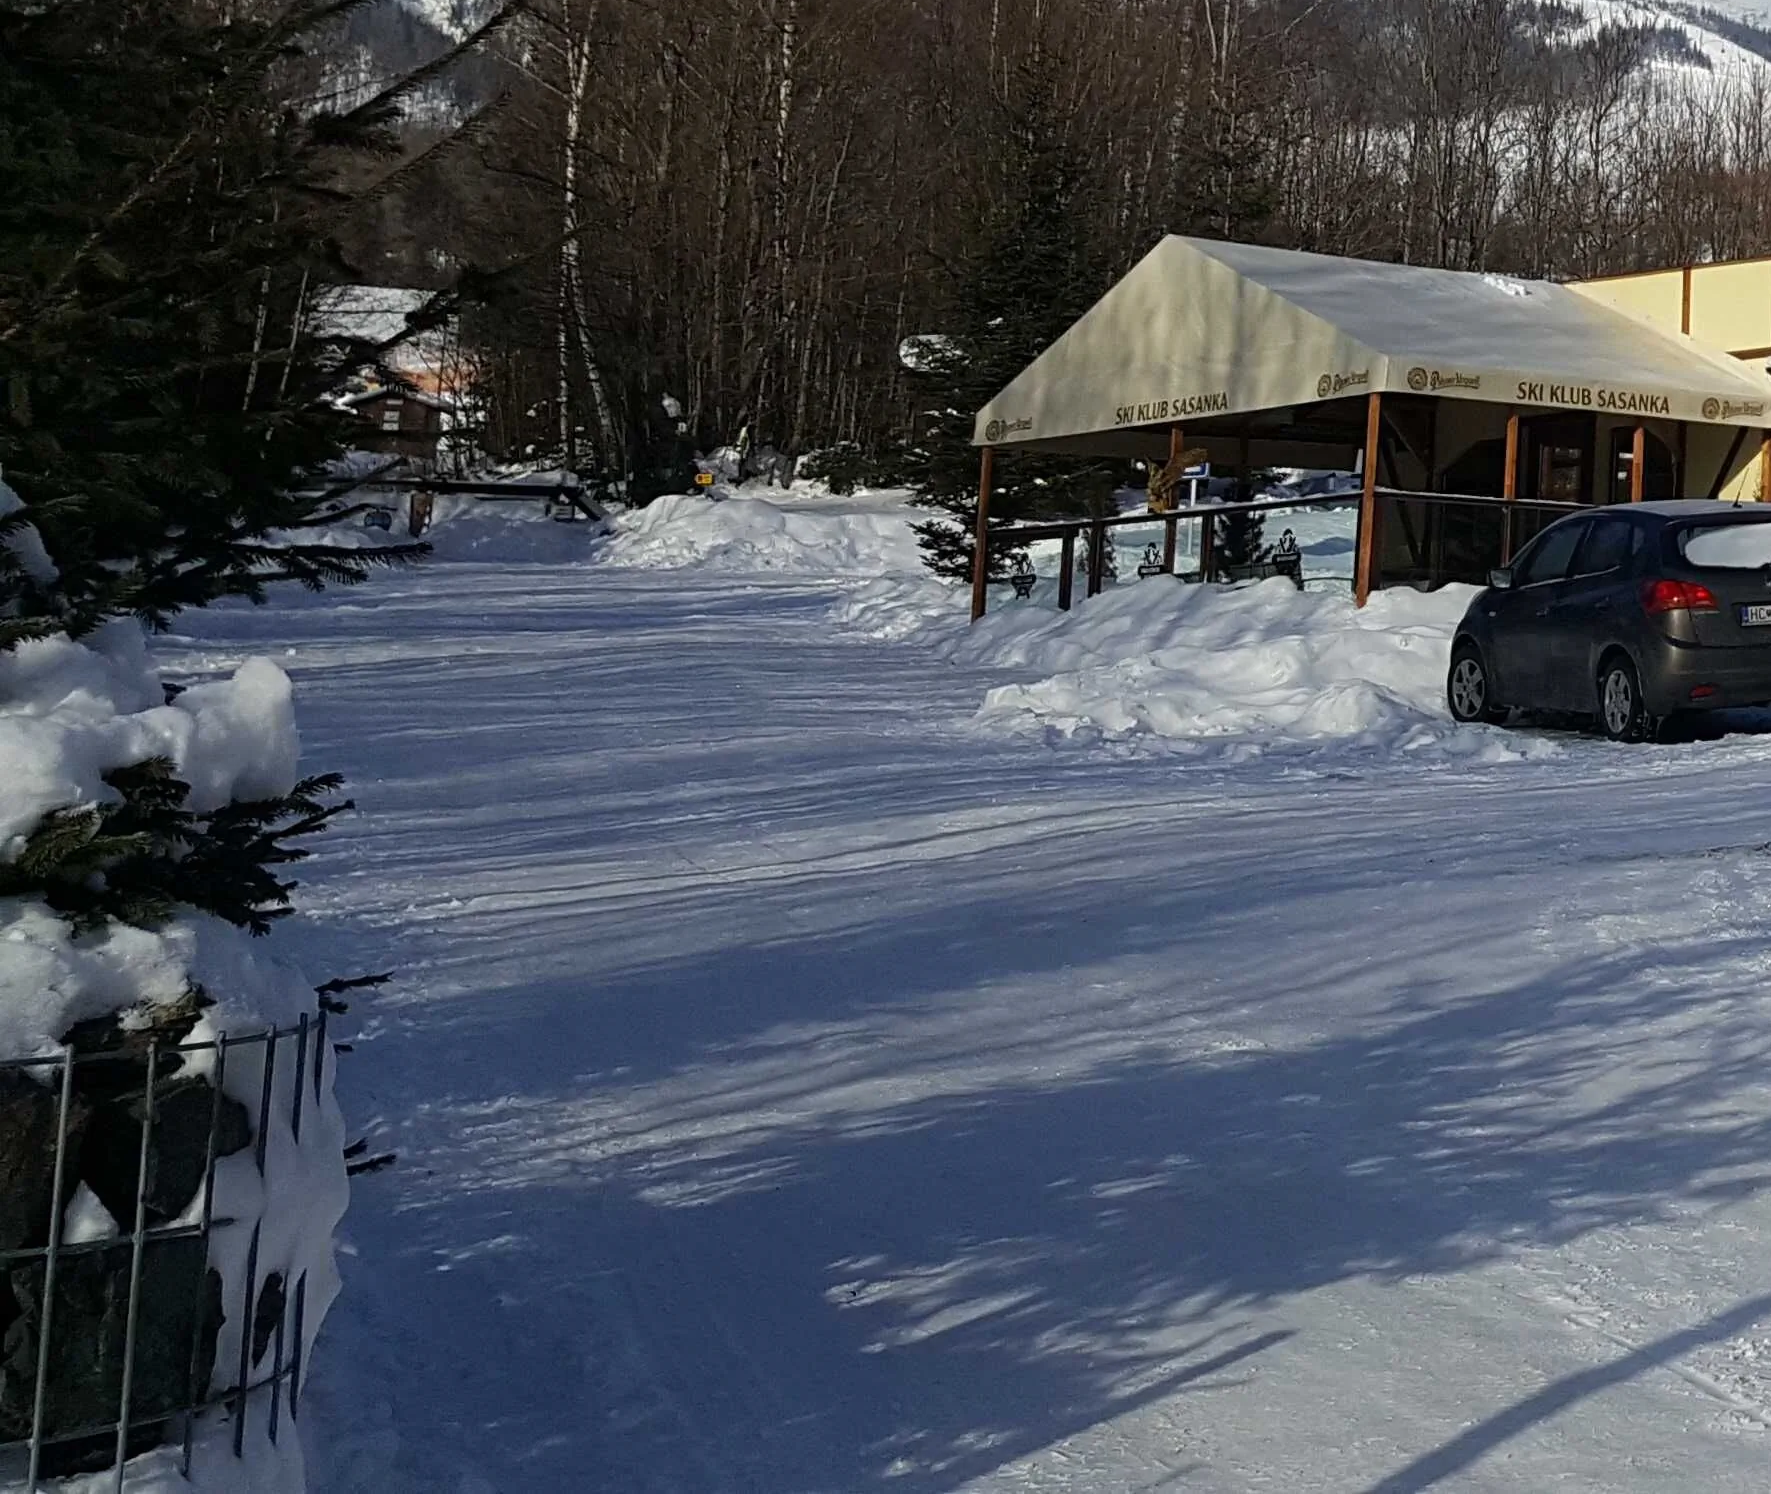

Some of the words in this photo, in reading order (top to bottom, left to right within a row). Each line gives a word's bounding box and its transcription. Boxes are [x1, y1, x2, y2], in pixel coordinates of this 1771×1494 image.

[1115, 406, 1134, 425] SKI
[1137, 401, 1168, 422] KLUB
[1171, 392, 1228, 417] SASANKA
[1516, 381, 1544, 402] SKI
[1550, 384, 1591, 406] KLUB
[1597, 389, 1670, 414] SASANKA
